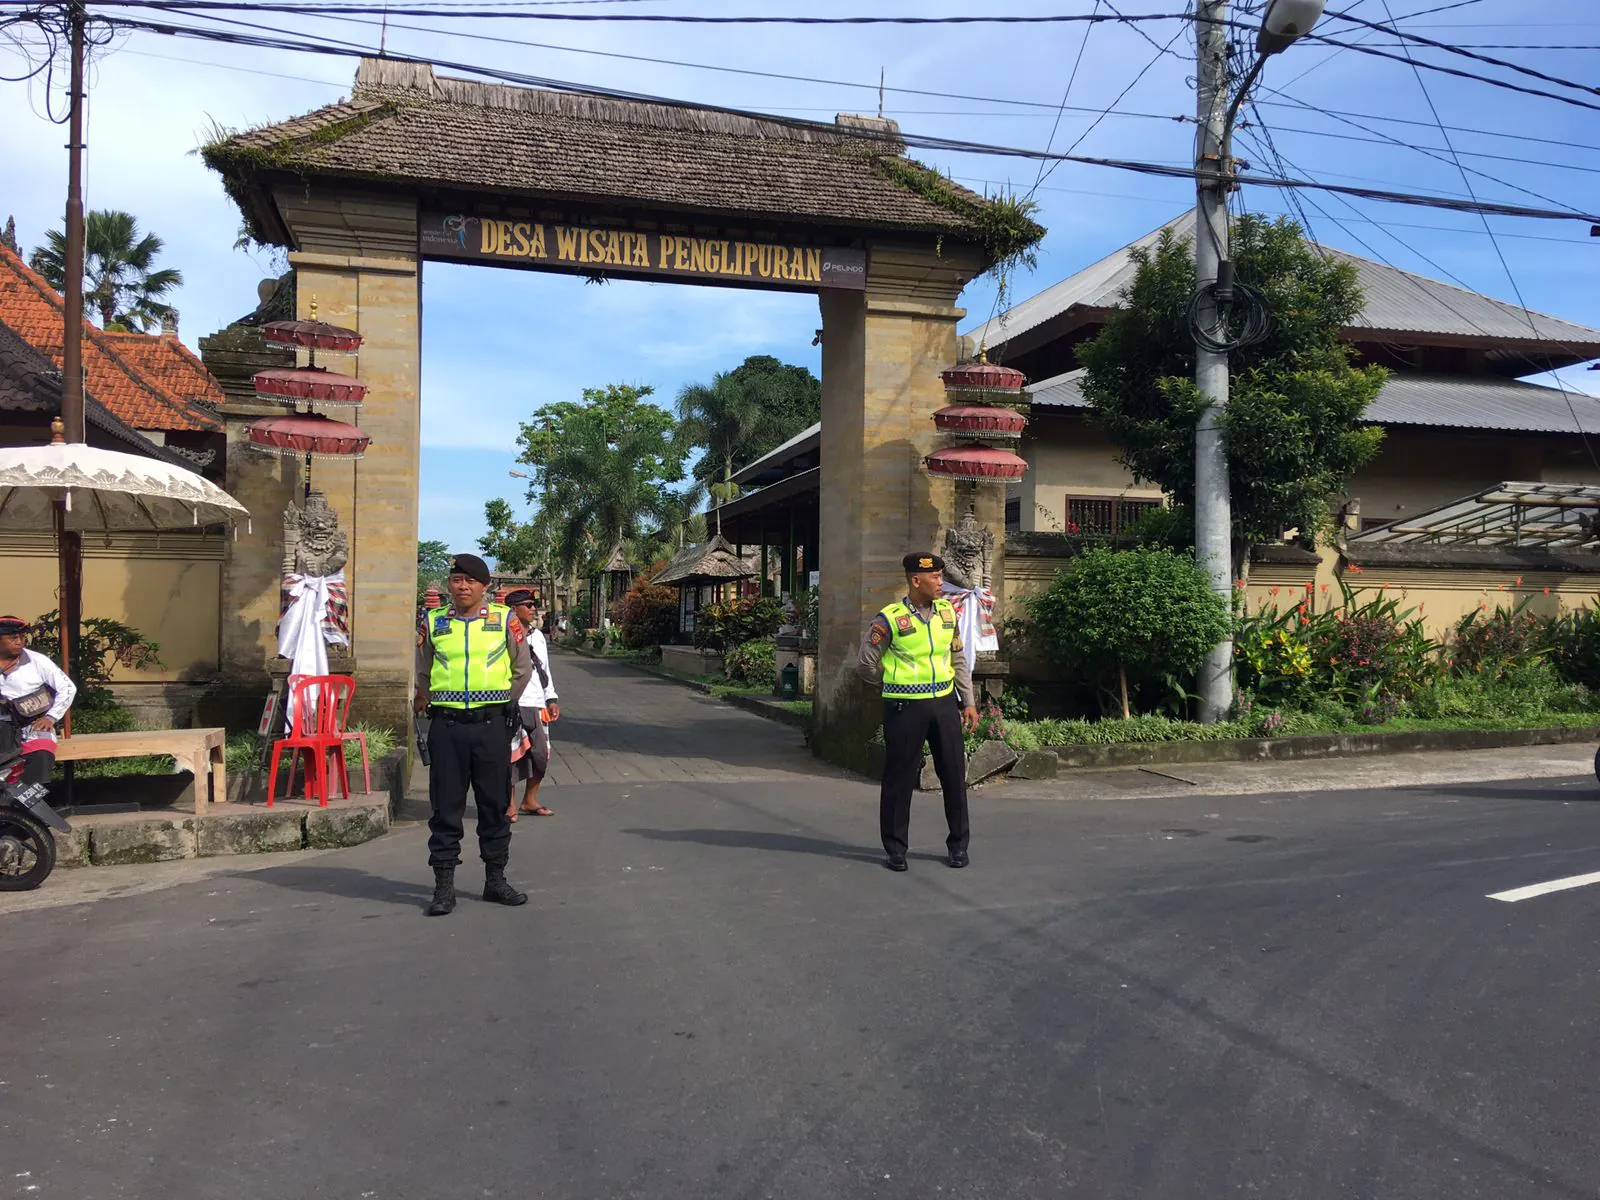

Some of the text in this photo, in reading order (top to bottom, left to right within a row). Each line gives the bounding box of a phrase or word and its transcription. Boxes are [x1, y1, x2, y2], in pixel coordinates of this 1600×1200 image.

[480, 218, 822, 281] DESA WISATA PENGLIPURAN
[832, 264, 864, 273] PELINDO
